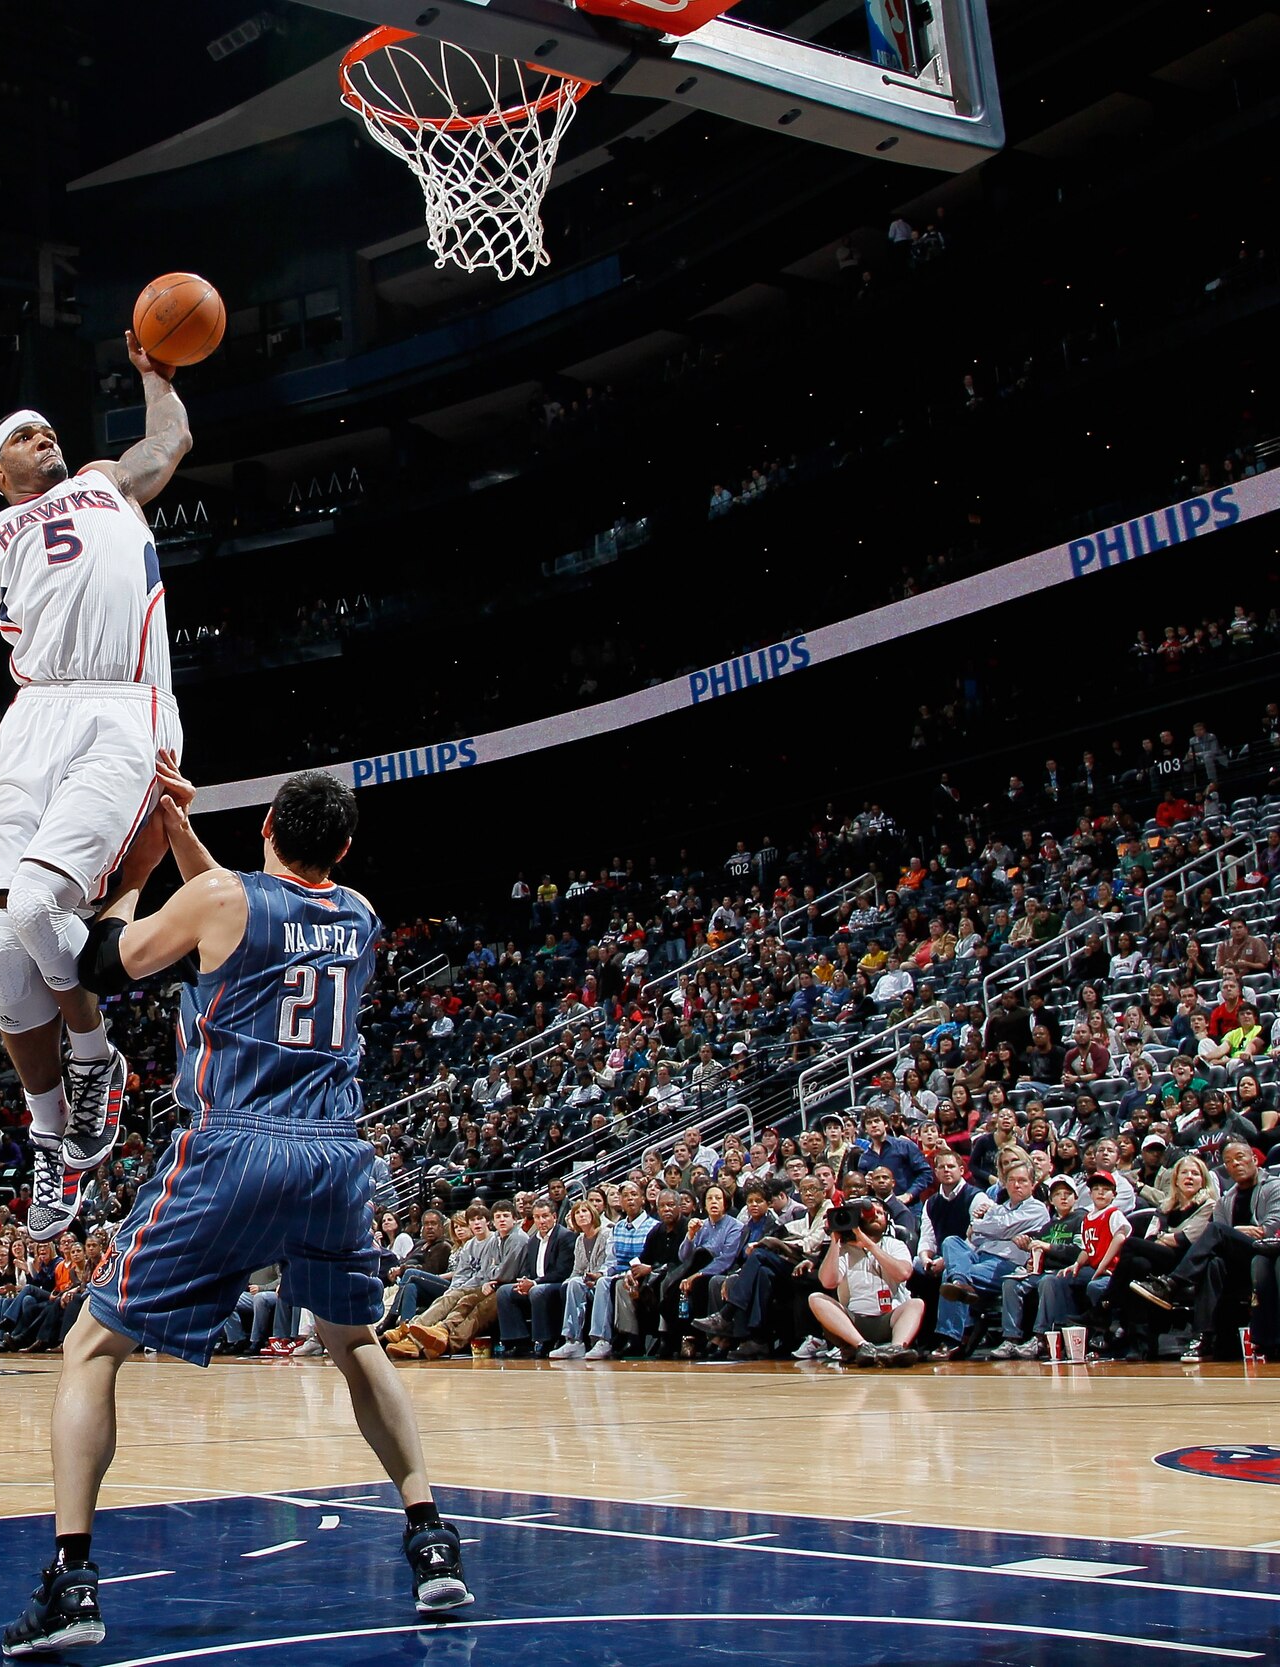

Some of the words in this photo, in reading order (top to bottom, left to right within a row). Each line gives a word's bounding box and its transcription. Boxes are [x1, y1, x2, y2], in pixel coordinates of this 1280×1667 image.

[41, 517, 84, 566] 5
[1068, 486, 1240, 579] PHILIPS
[688, 635, 811, 704] PHILIPS
[352, 738, 477, 789] PHILIPS
[1157, 758, 1181, 775] 103
[730, 862, 750, 876] 102
[282, 921, 359, 958] NAJERA
[277, 964, 348, 1050] 21
